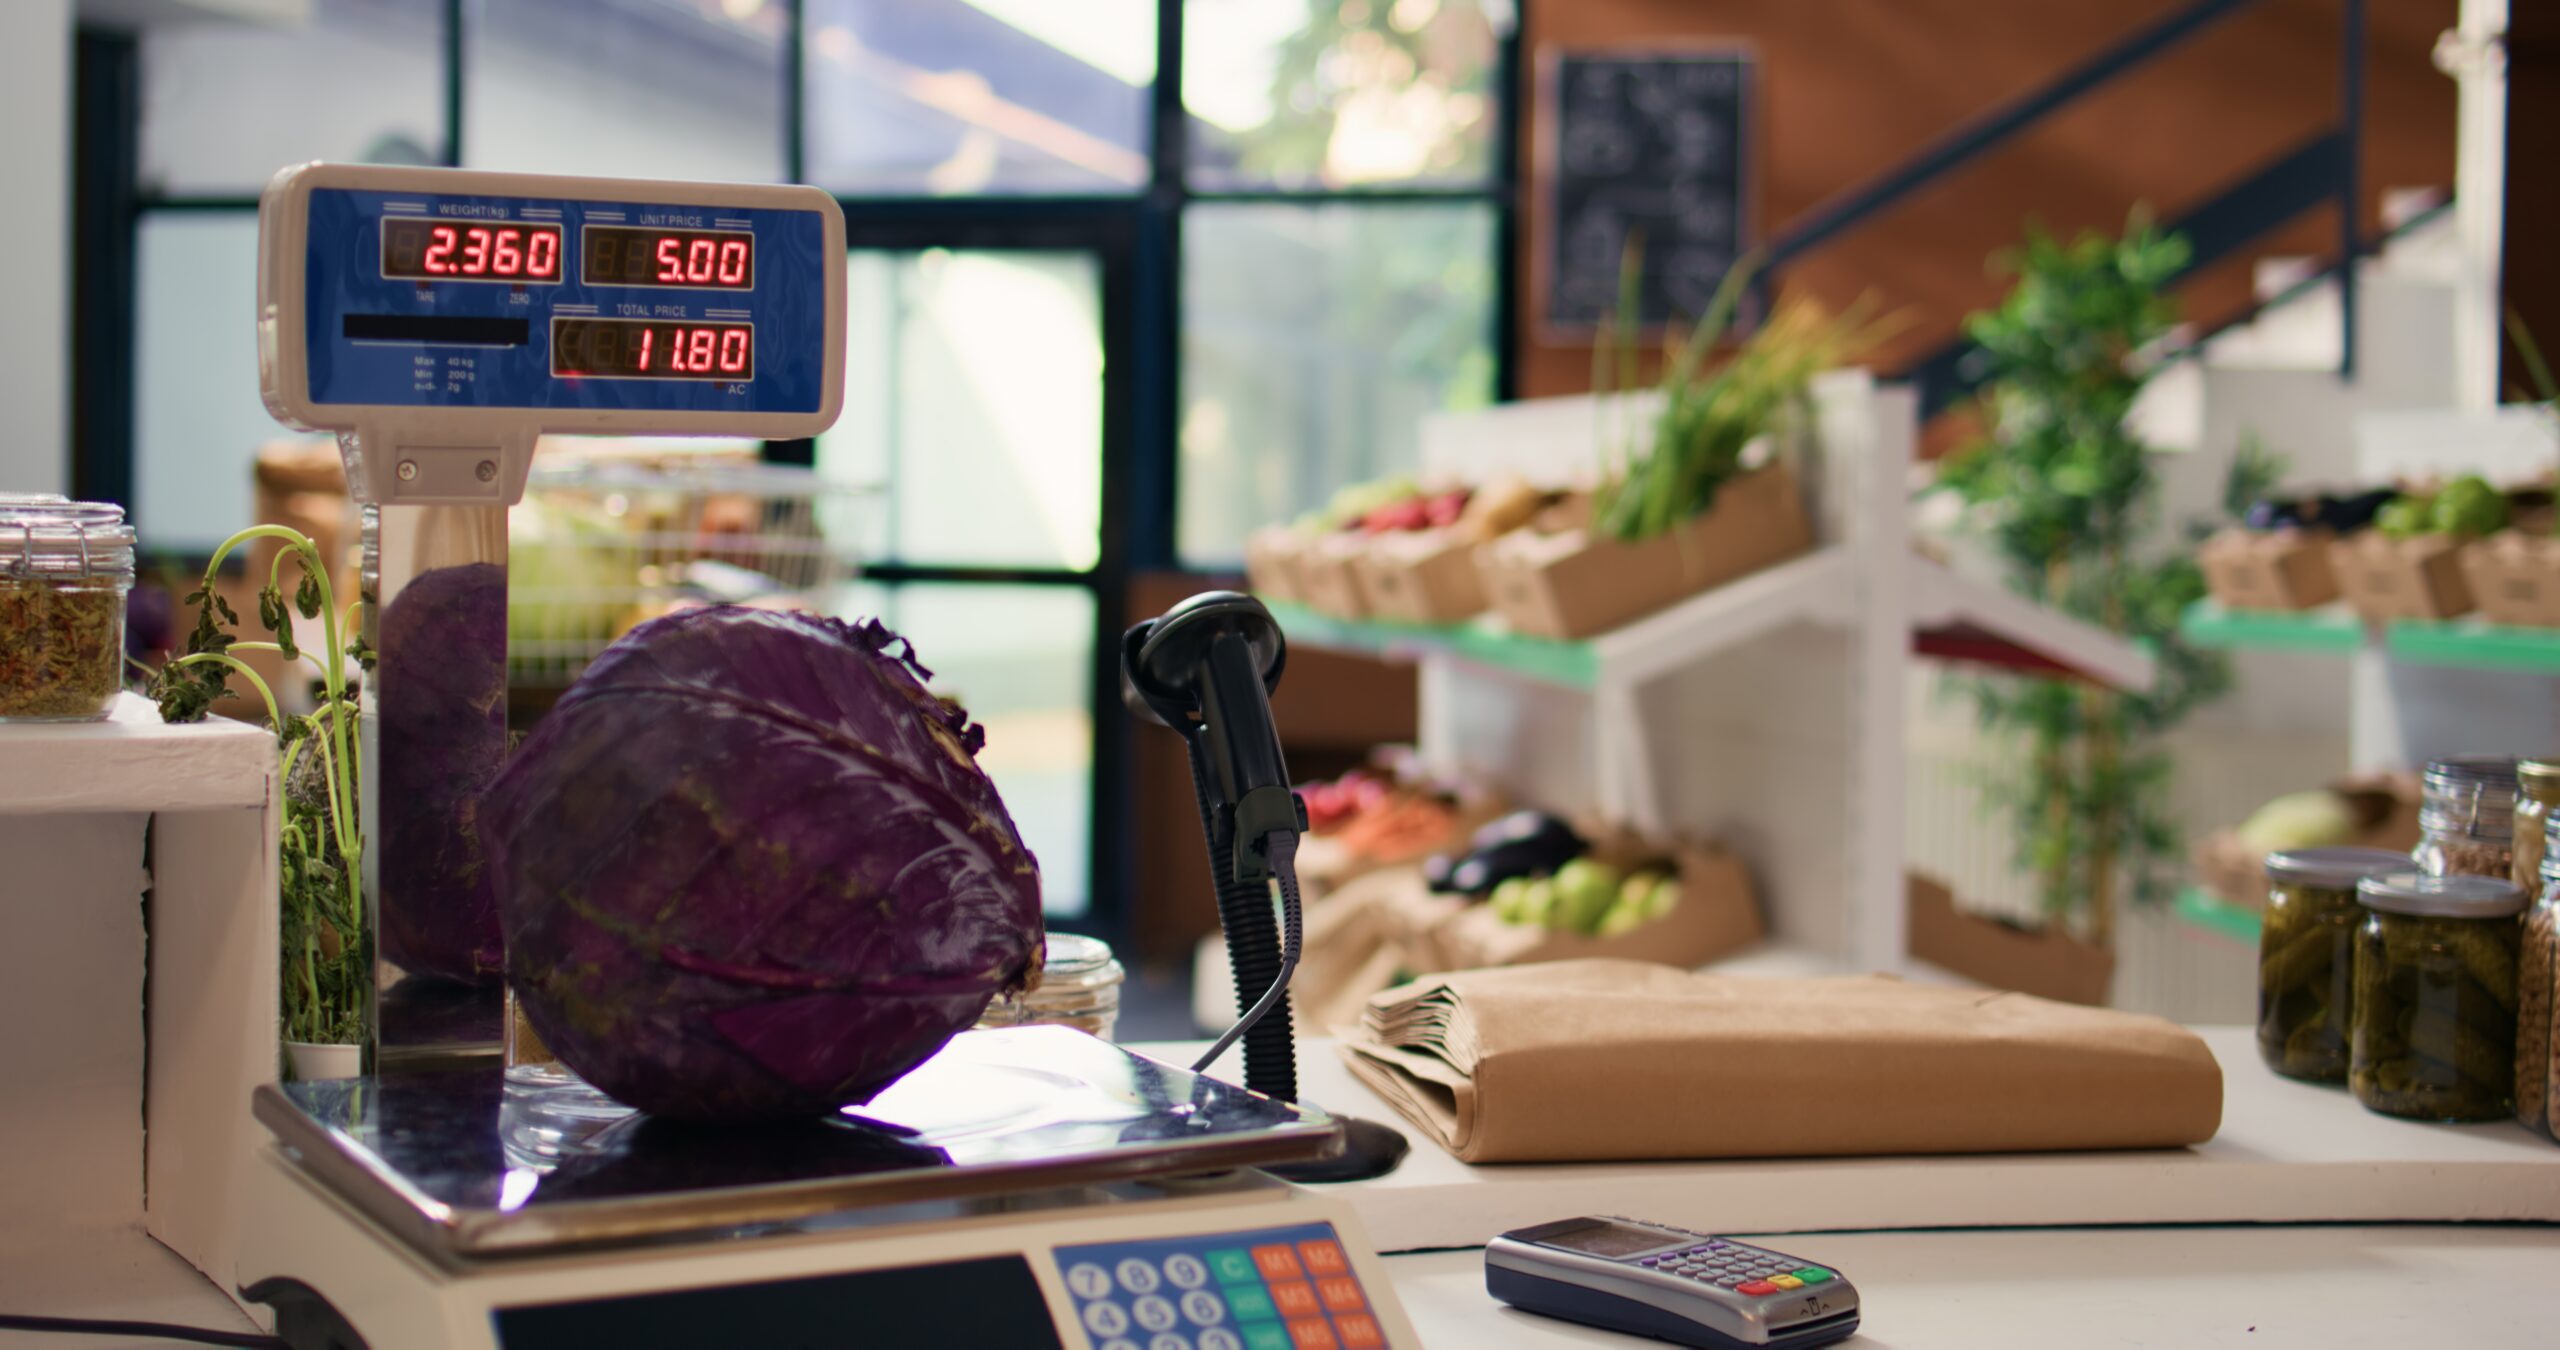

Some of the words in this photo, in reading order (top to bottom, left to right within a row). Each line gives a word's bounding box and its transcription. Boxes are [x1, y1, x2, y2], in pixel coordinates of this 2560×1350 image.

[439, 204, 509, 218] WEIGHT(kg)
[639, 214, 666, 225] UNIT
[669, 216, 703, 227] PRICE
[424, 227, 558, 276] 2.360
[657, 238, 747, 284] 5.00
[509, 293, 530, 305] ZERO
[617, 304, 649, 316] TOTAL
[655, 305, 686, 318] PRICE
[639, 328, 748, 372] 11.80
[414, 356, 435, 366] Max
[414, 369, 433, 379] Min
[447, 370, 466, 380] 200
[728, 384, 746, 395] AC
[1077, 1269, 1096, 1294] 7
[1128, 1264, 1150, 1289] 8
[1174, 1260, 1197, 1284] 9
[1221, 1255, 1245, 1278] C
[1263, 1252, 1294, 1271] M1
[1307, 1247, 1340, 1267] M2
[1098, 1306, 1118, 1329] 4
[1144, 1301, 1168, 1326] 5
[1193, 1296, 1215, 1321] 6
[1279, 1287, 1311, 1309] M3
[1325, 1283, 1357, 1304] M4
